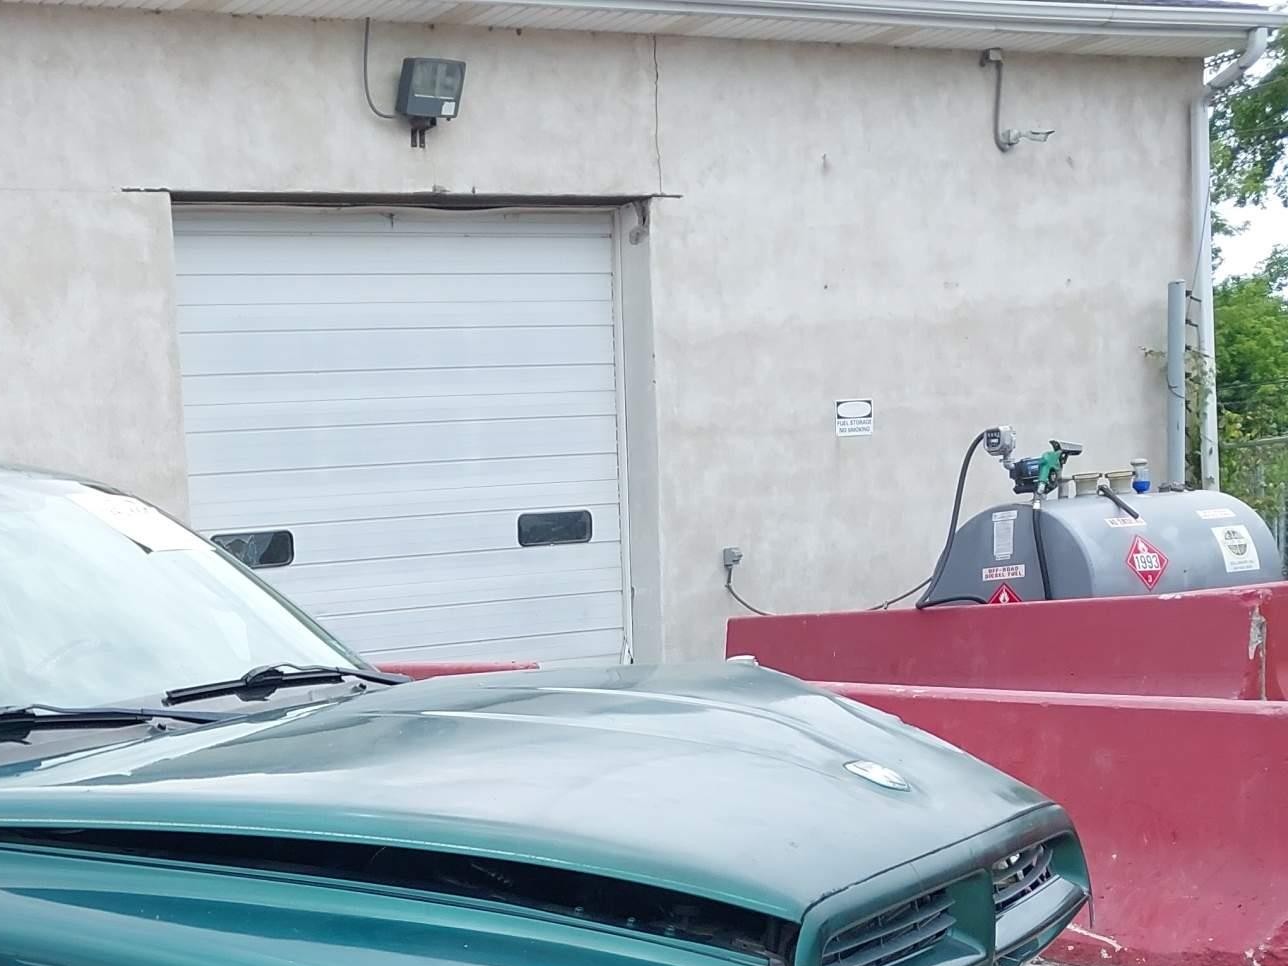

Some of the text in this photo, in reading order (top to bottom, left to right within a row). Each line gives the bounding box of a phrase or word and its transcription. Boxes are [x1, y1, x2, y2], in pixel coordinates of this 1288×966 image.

[1136, 554, 1160, 570] 1993
[988, 566, 1019, 574] OFF-ROAD
[1147, 575, 1153, 583] 3
